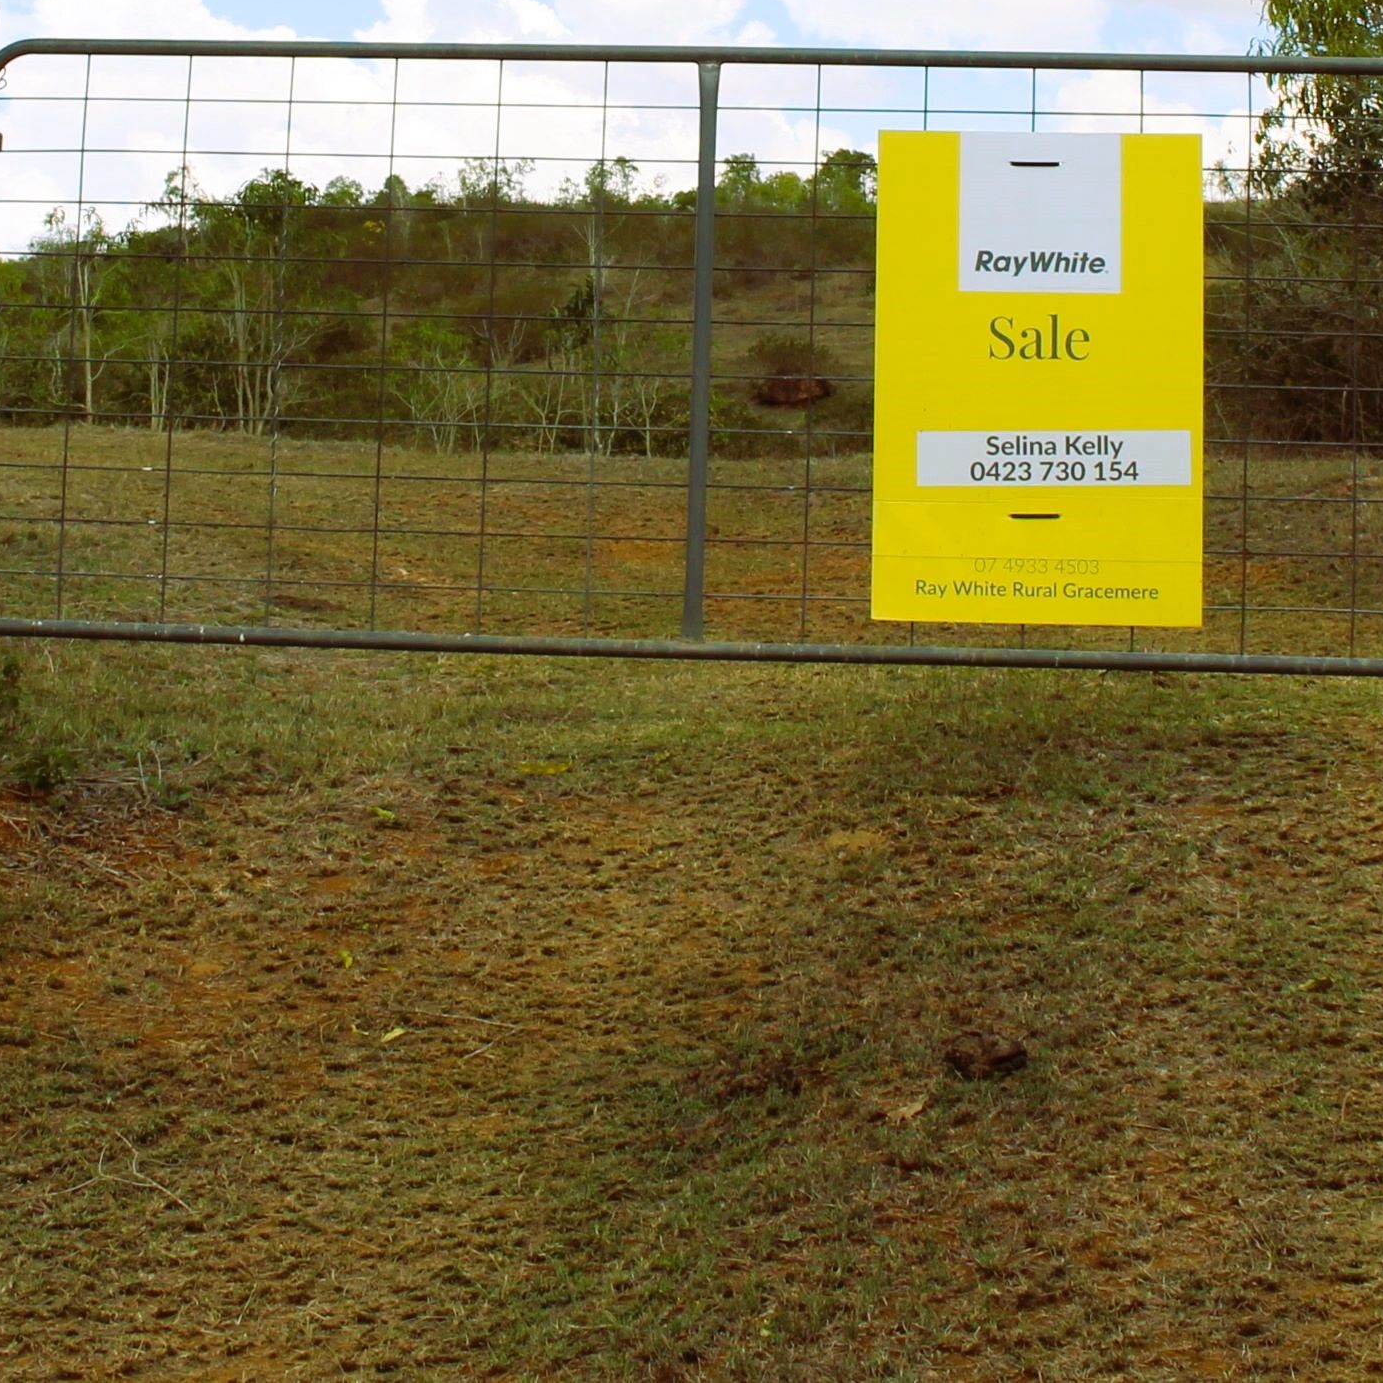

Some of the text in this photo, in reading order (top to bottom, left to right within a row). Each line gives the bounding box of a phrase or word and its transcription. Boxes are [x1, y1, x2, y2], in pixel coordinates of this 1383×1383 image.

[989, 313, 1091, 361] Sale
[986, 434, 1124, 459] Selina Kelly
[970, 461, 1139, 482] 0423 730 154
[973, 557, 996, 573] 07
[1002, 557, 1048, 574] 4933
[915, 579, 1159, 599] Ray White Rural Gracemere
